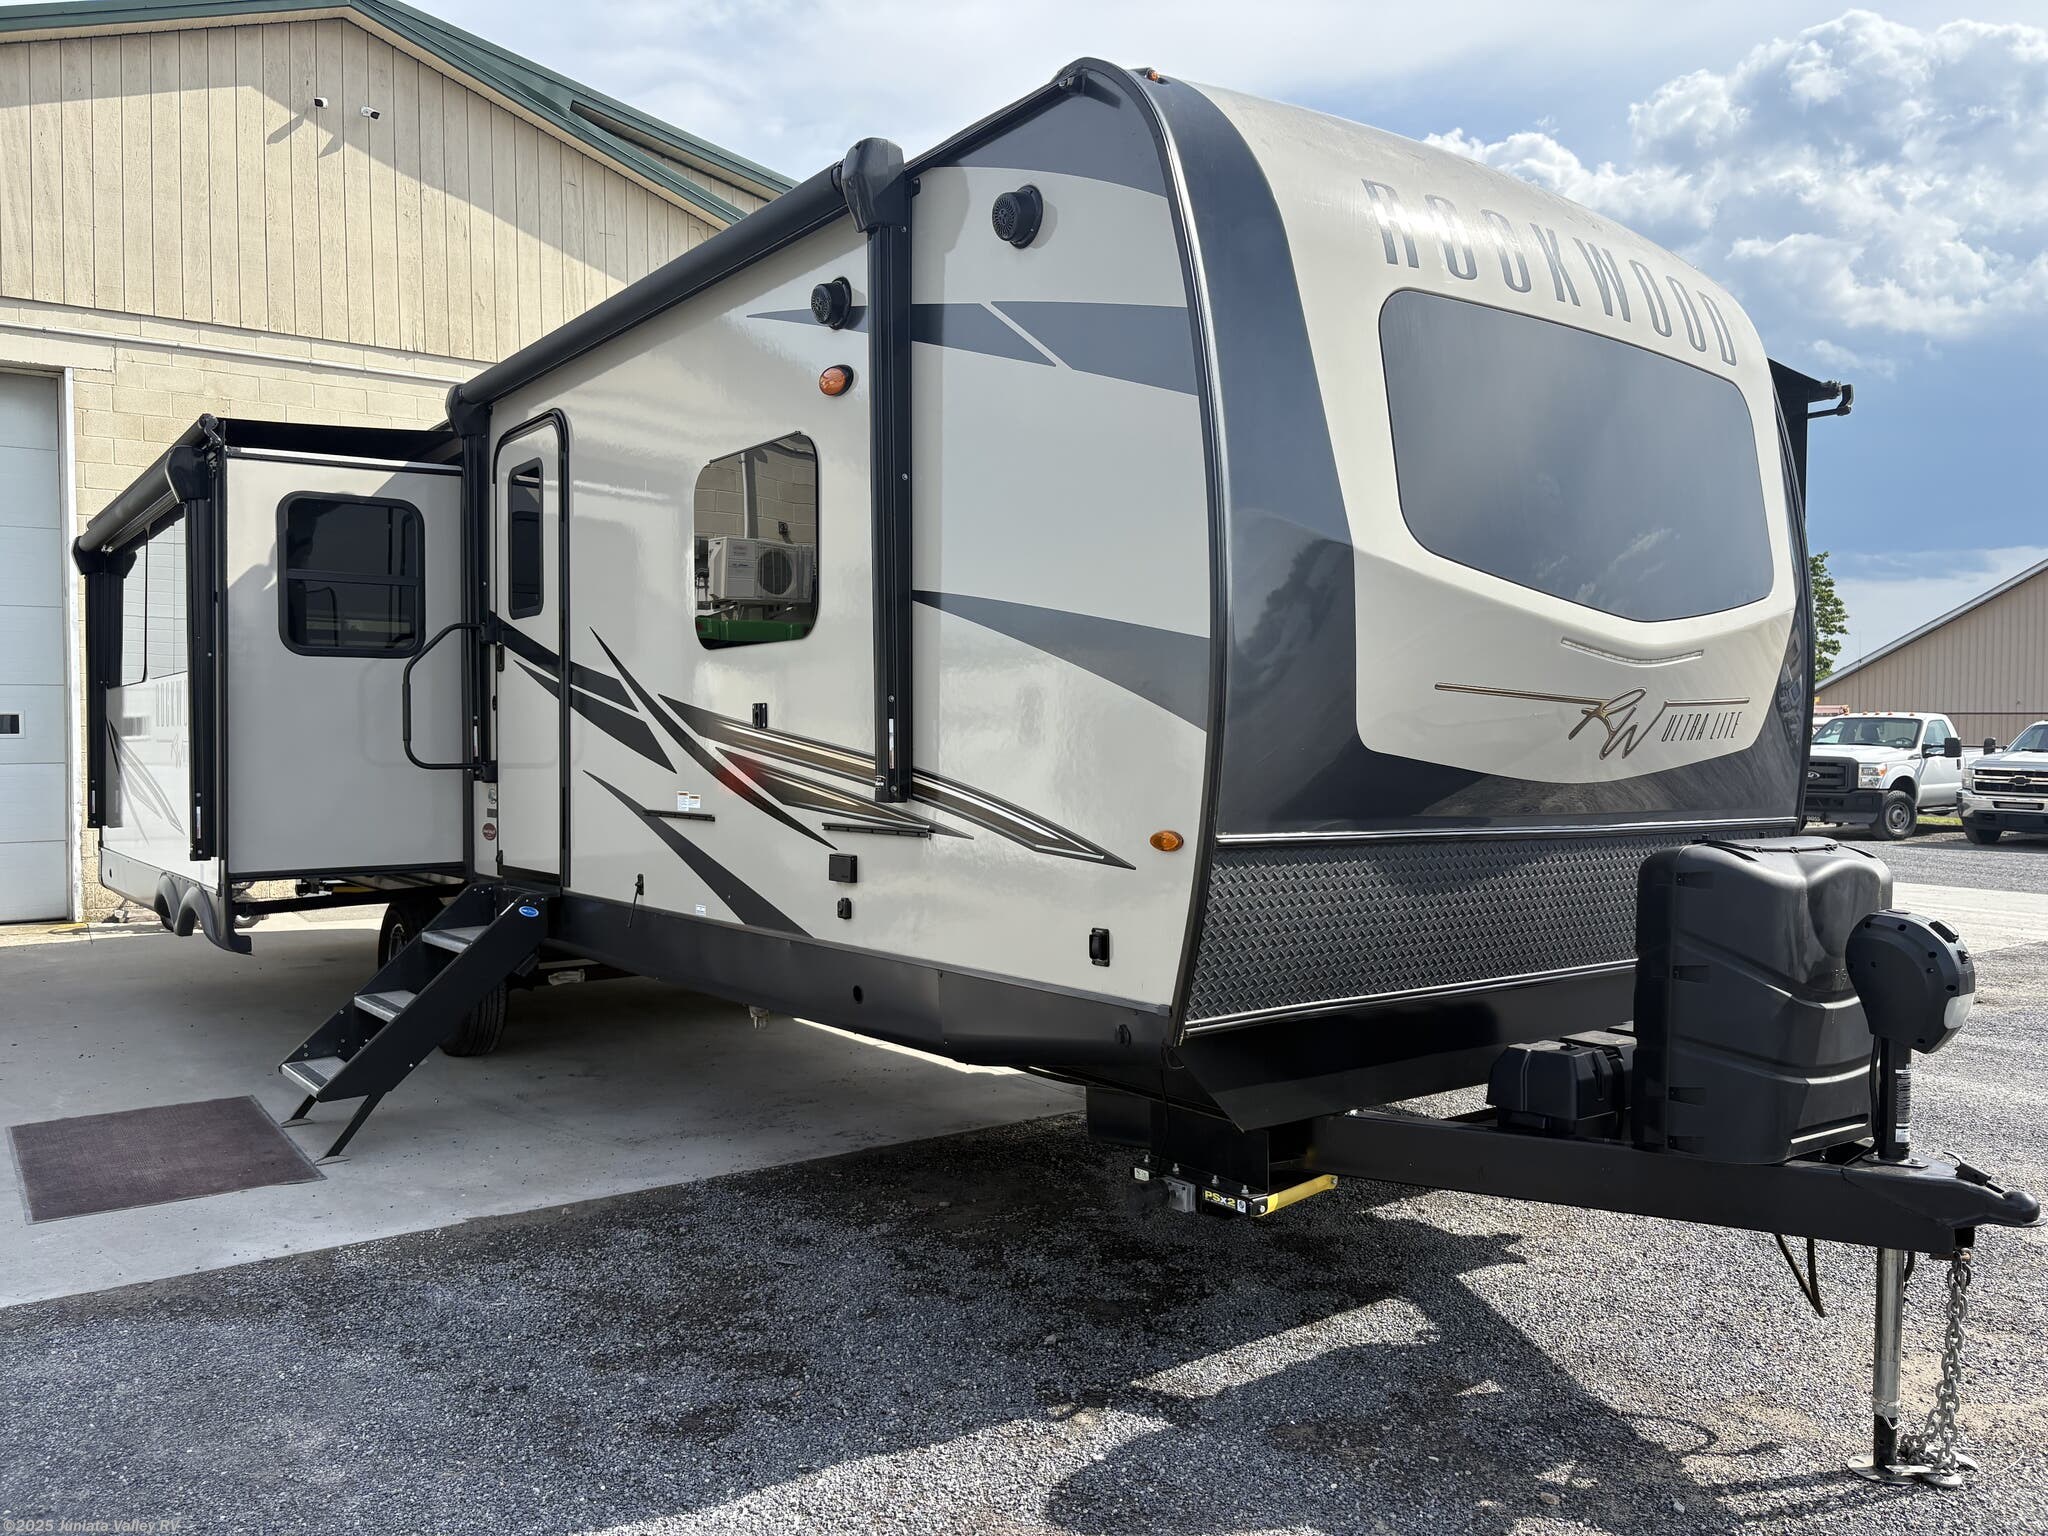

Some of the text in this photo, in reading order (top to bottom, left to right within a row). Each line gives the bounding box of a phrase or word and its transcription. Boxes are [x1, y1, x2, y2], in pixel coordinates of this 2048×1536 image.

[1361, 178, 1738, 366] ROCKWOOD
[1567, 687, 1743, 760] RW ULTRA LITE
[1204, 1189, 1236, 1207] PSx2
